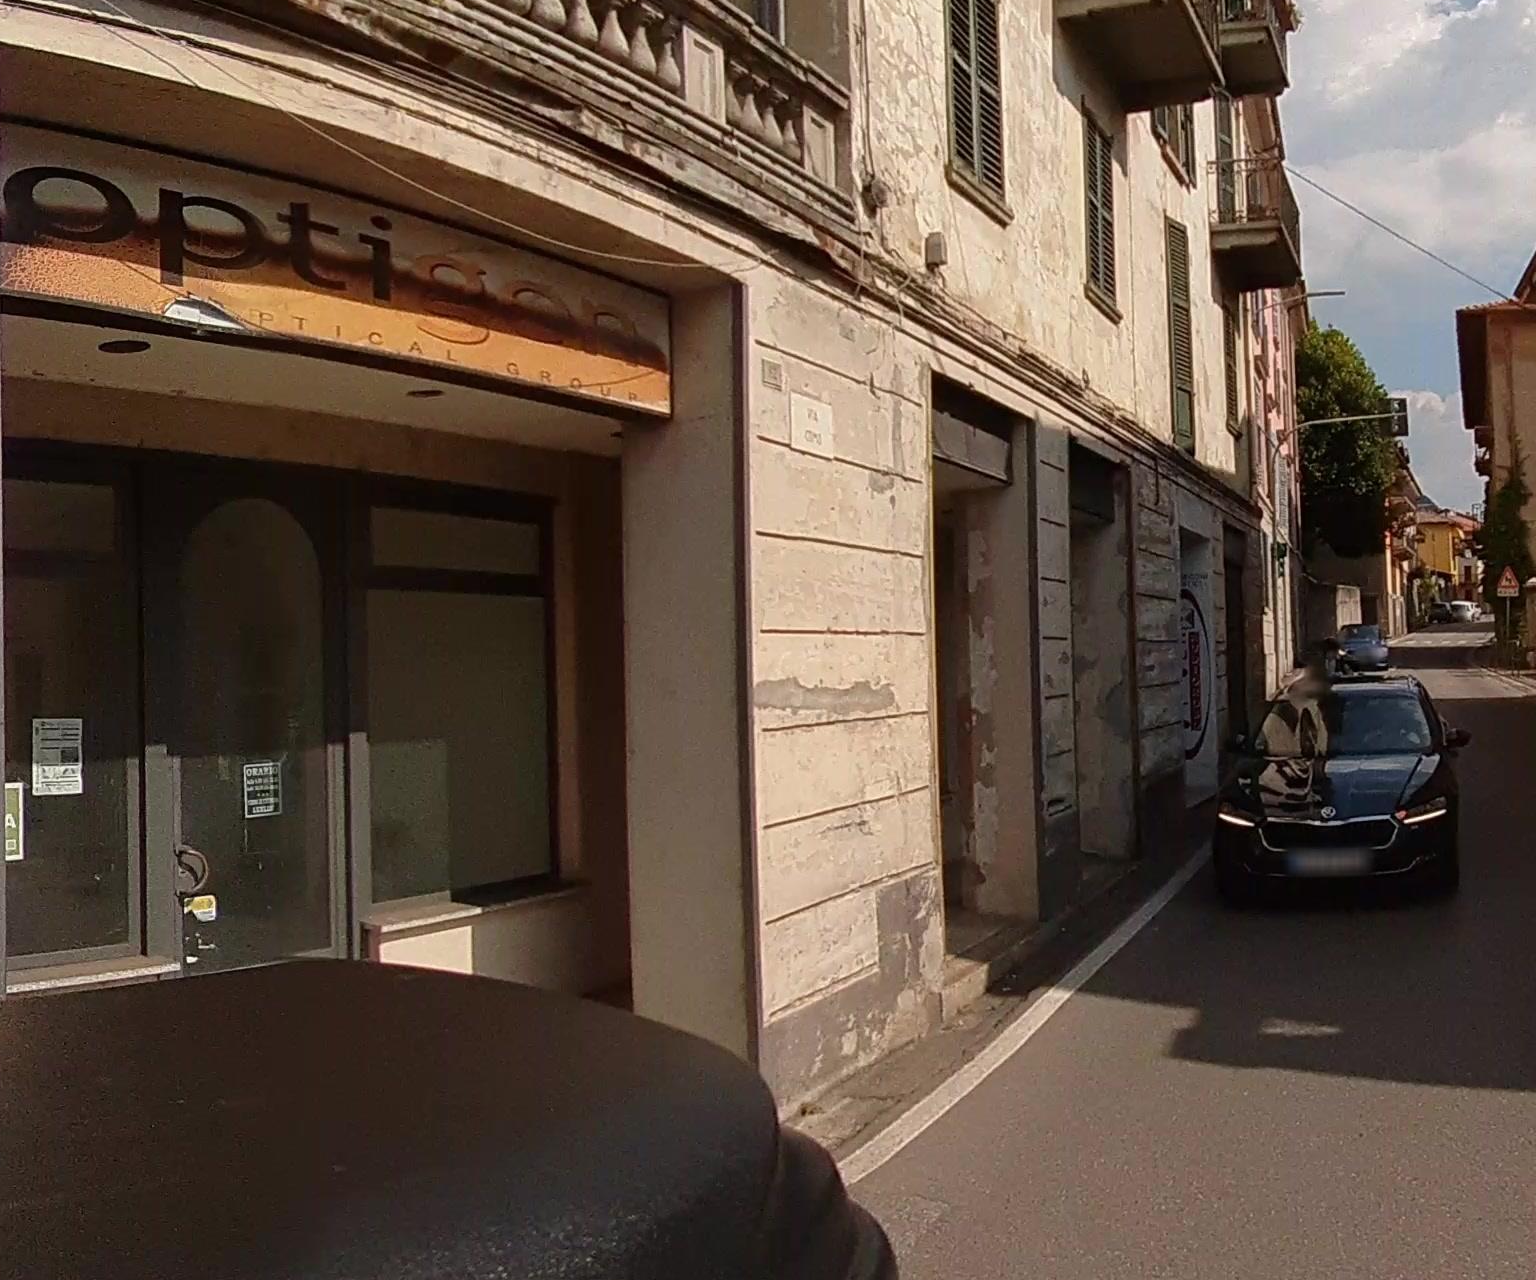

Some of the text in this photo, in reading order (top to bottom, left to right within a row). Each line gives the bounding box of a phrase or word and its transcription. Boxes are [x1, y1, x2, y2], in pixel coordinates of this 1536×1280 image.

[252, 310, 640, 404] PTICAL GROUP
[246, 766, 278, 777] ORARIO
